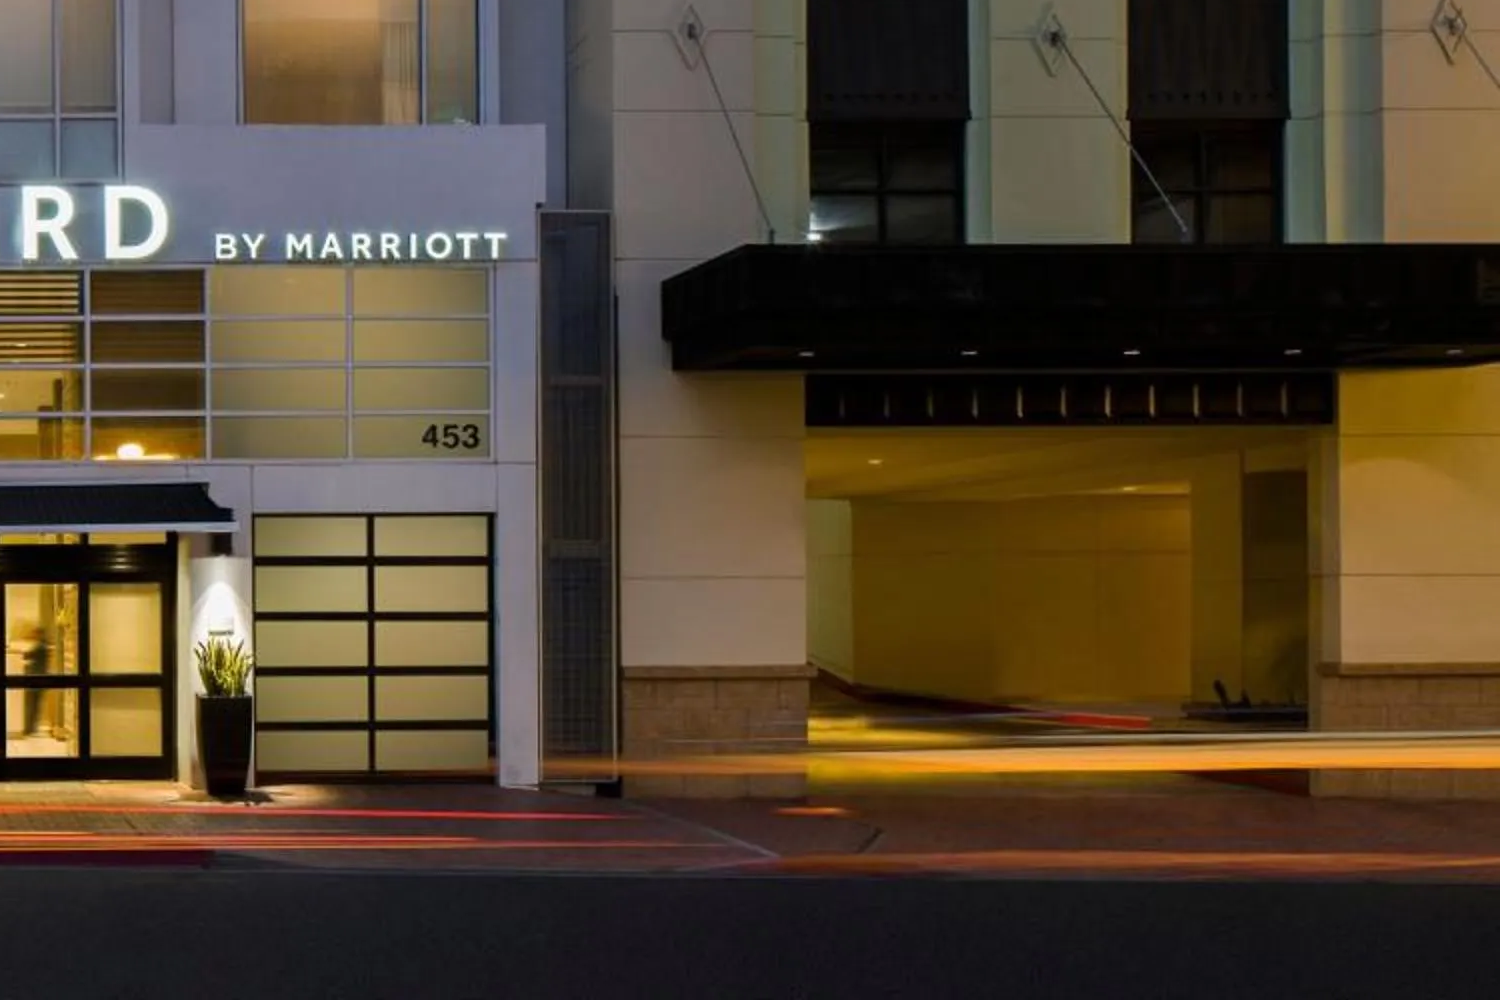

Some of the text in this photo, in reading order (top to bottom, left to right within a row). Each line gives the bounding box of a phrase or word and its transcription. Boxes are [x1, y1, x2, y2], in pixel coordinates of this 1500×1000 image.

[215, 233, 264, 260] BY
[285, 232, 508, 260] MARRIOTT
[421, 423, 480, 449] 453
